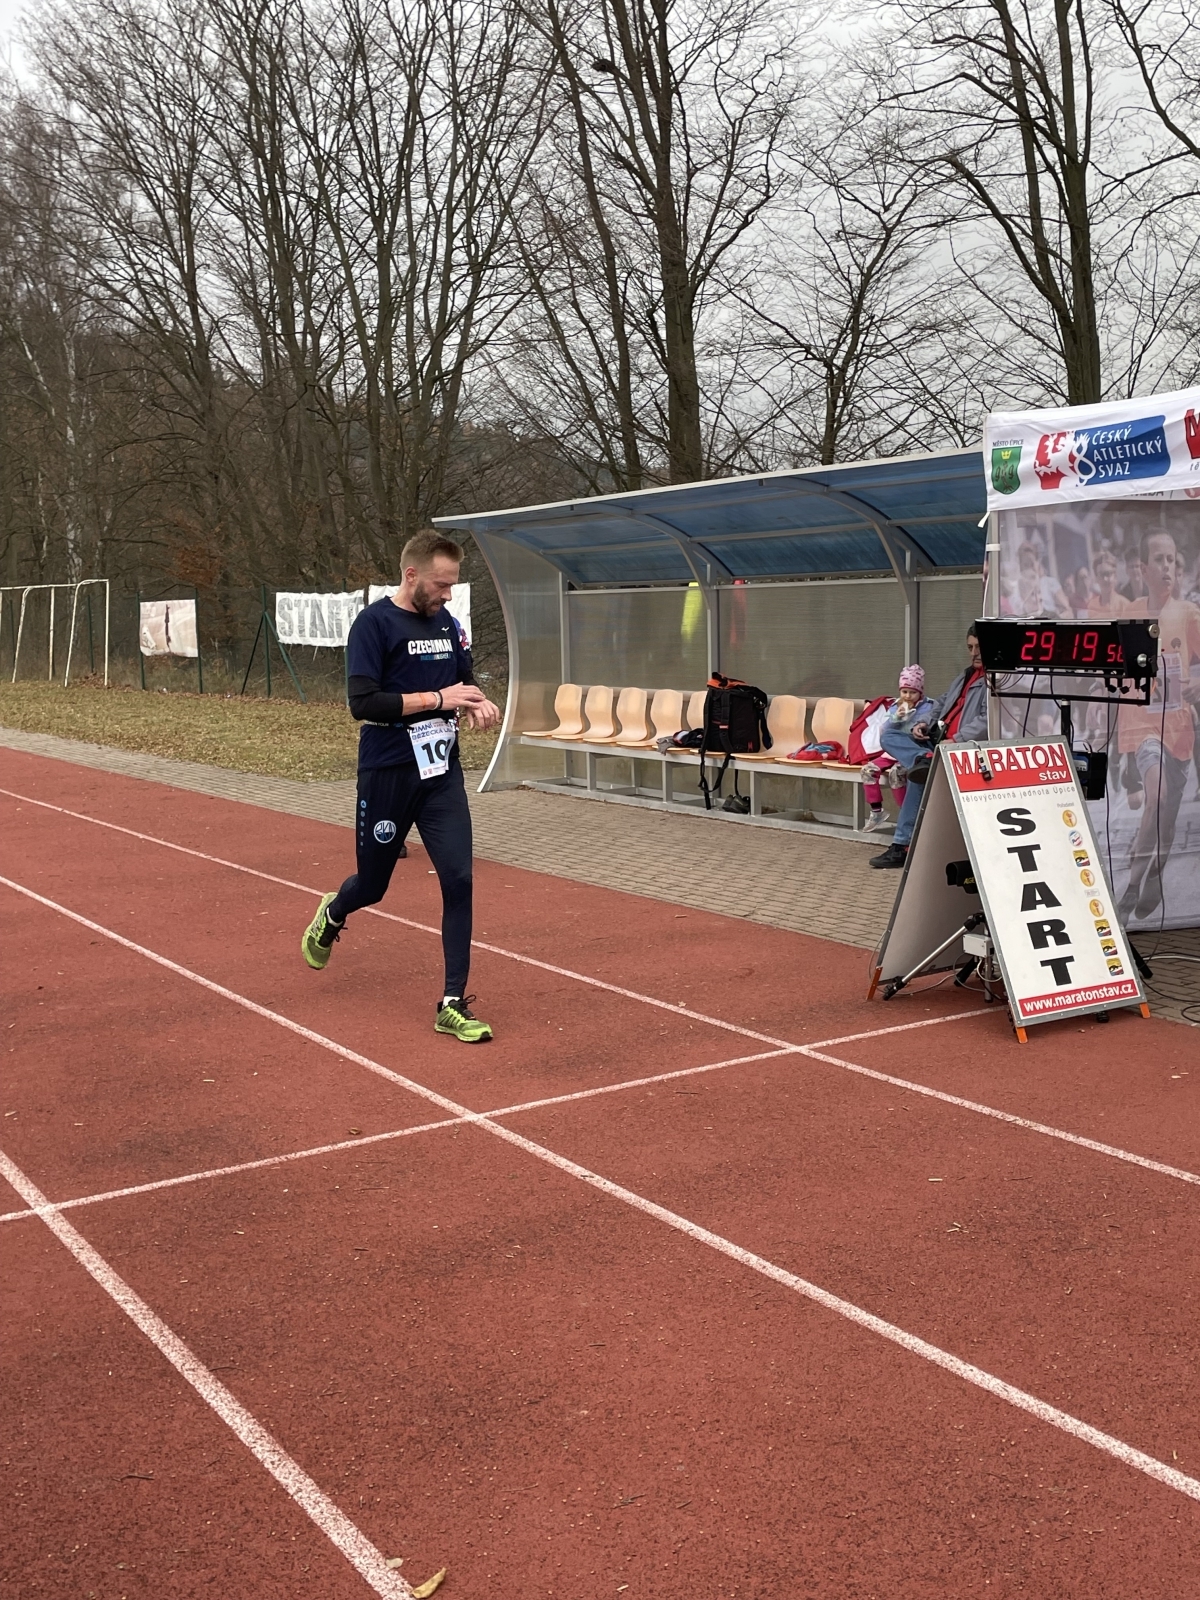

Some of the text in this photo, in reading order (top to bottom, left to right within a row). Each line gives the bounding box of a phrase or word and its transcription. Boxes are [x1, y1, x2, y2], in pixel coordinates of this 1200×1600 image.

[1092, 425, 1132, 446] ČESKÝ
[1093, 436, 1162, 463] ATLETICKÝ
[1098, 462, 1131, 478] SVAZ
[1021, 631, 1055, 661] 29
[1072, 632, 1099, 662] 19
[1039, 769, 1067, 781] stav
[962, 785, 1076, 803] tělovýchovná jednota Úpice
[997, 807, 1076, 987] START
[1023, 983, 1134, 1013] www.maratonstav.cz
